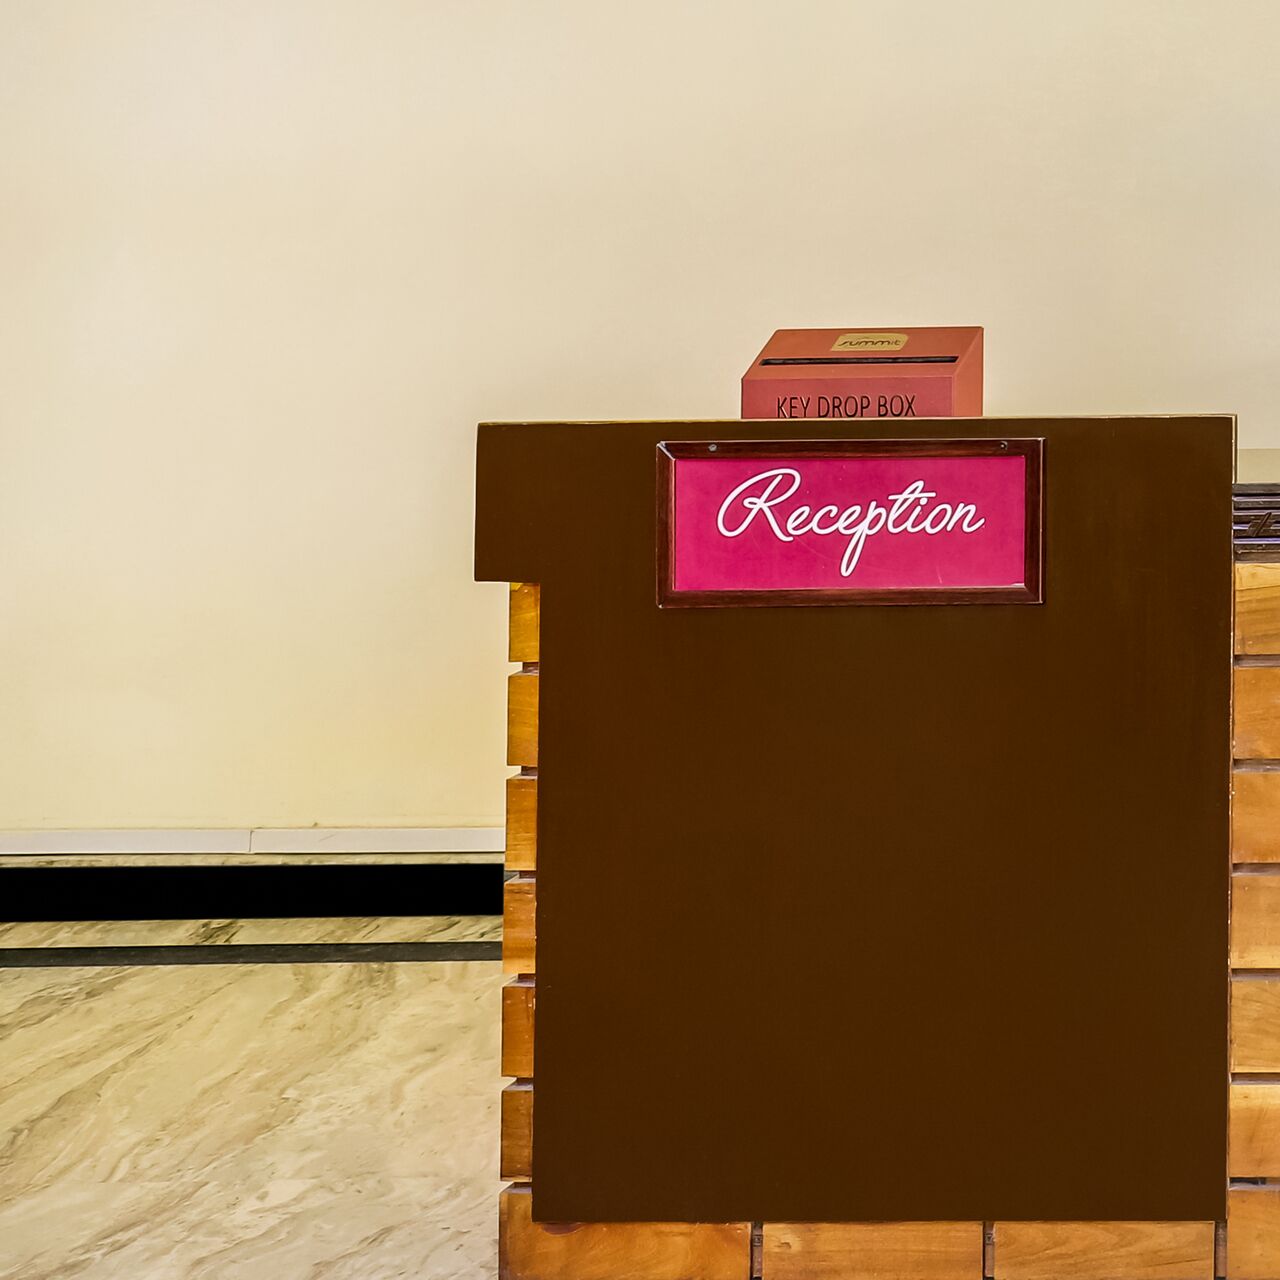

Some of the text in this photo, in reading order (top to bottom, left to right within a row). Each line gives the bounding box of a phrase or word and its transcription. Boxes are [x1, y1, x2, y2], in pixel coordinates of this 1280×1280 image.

[776, 394, 916, 419] KEY DROP BOX
[717, 467, 985, 577] Reception
